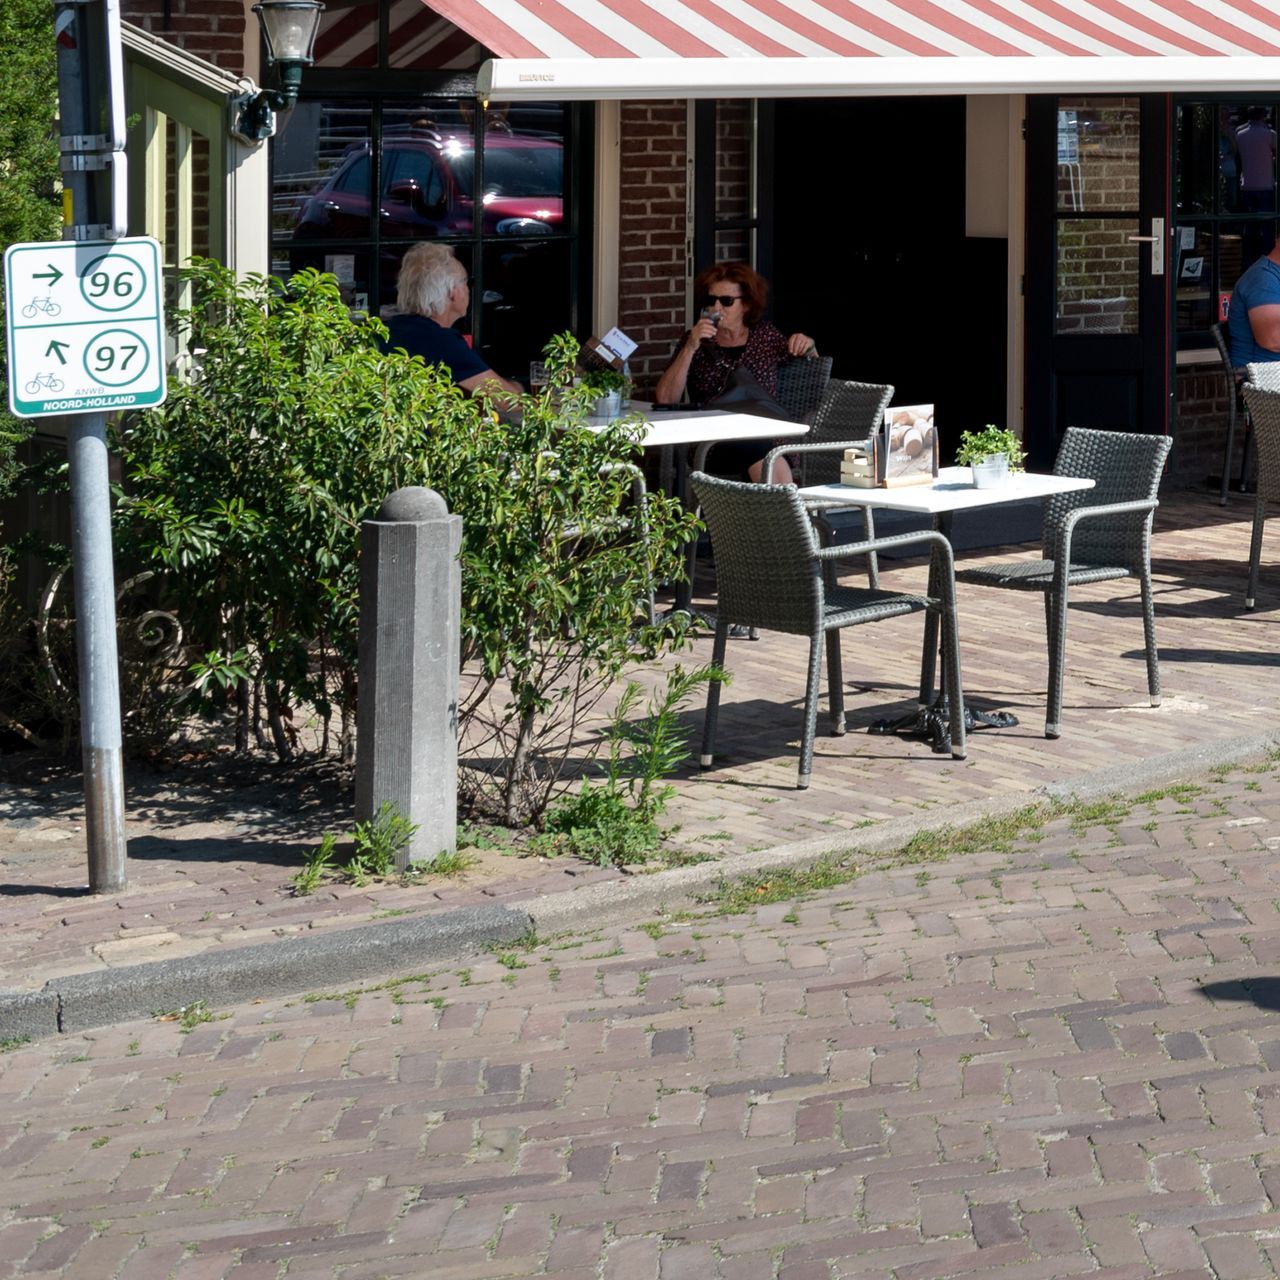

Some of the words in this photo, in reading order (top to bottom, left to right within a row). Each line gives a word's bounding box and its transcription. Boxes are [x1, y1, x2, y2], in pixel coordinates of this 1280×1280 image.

[89, 271, 134, 297] 96
[95, 345, 138, 371] 97
[74, 387, 105, 396] ANWB
[43, 395, 136, 411] NOORD-HOLLAND
